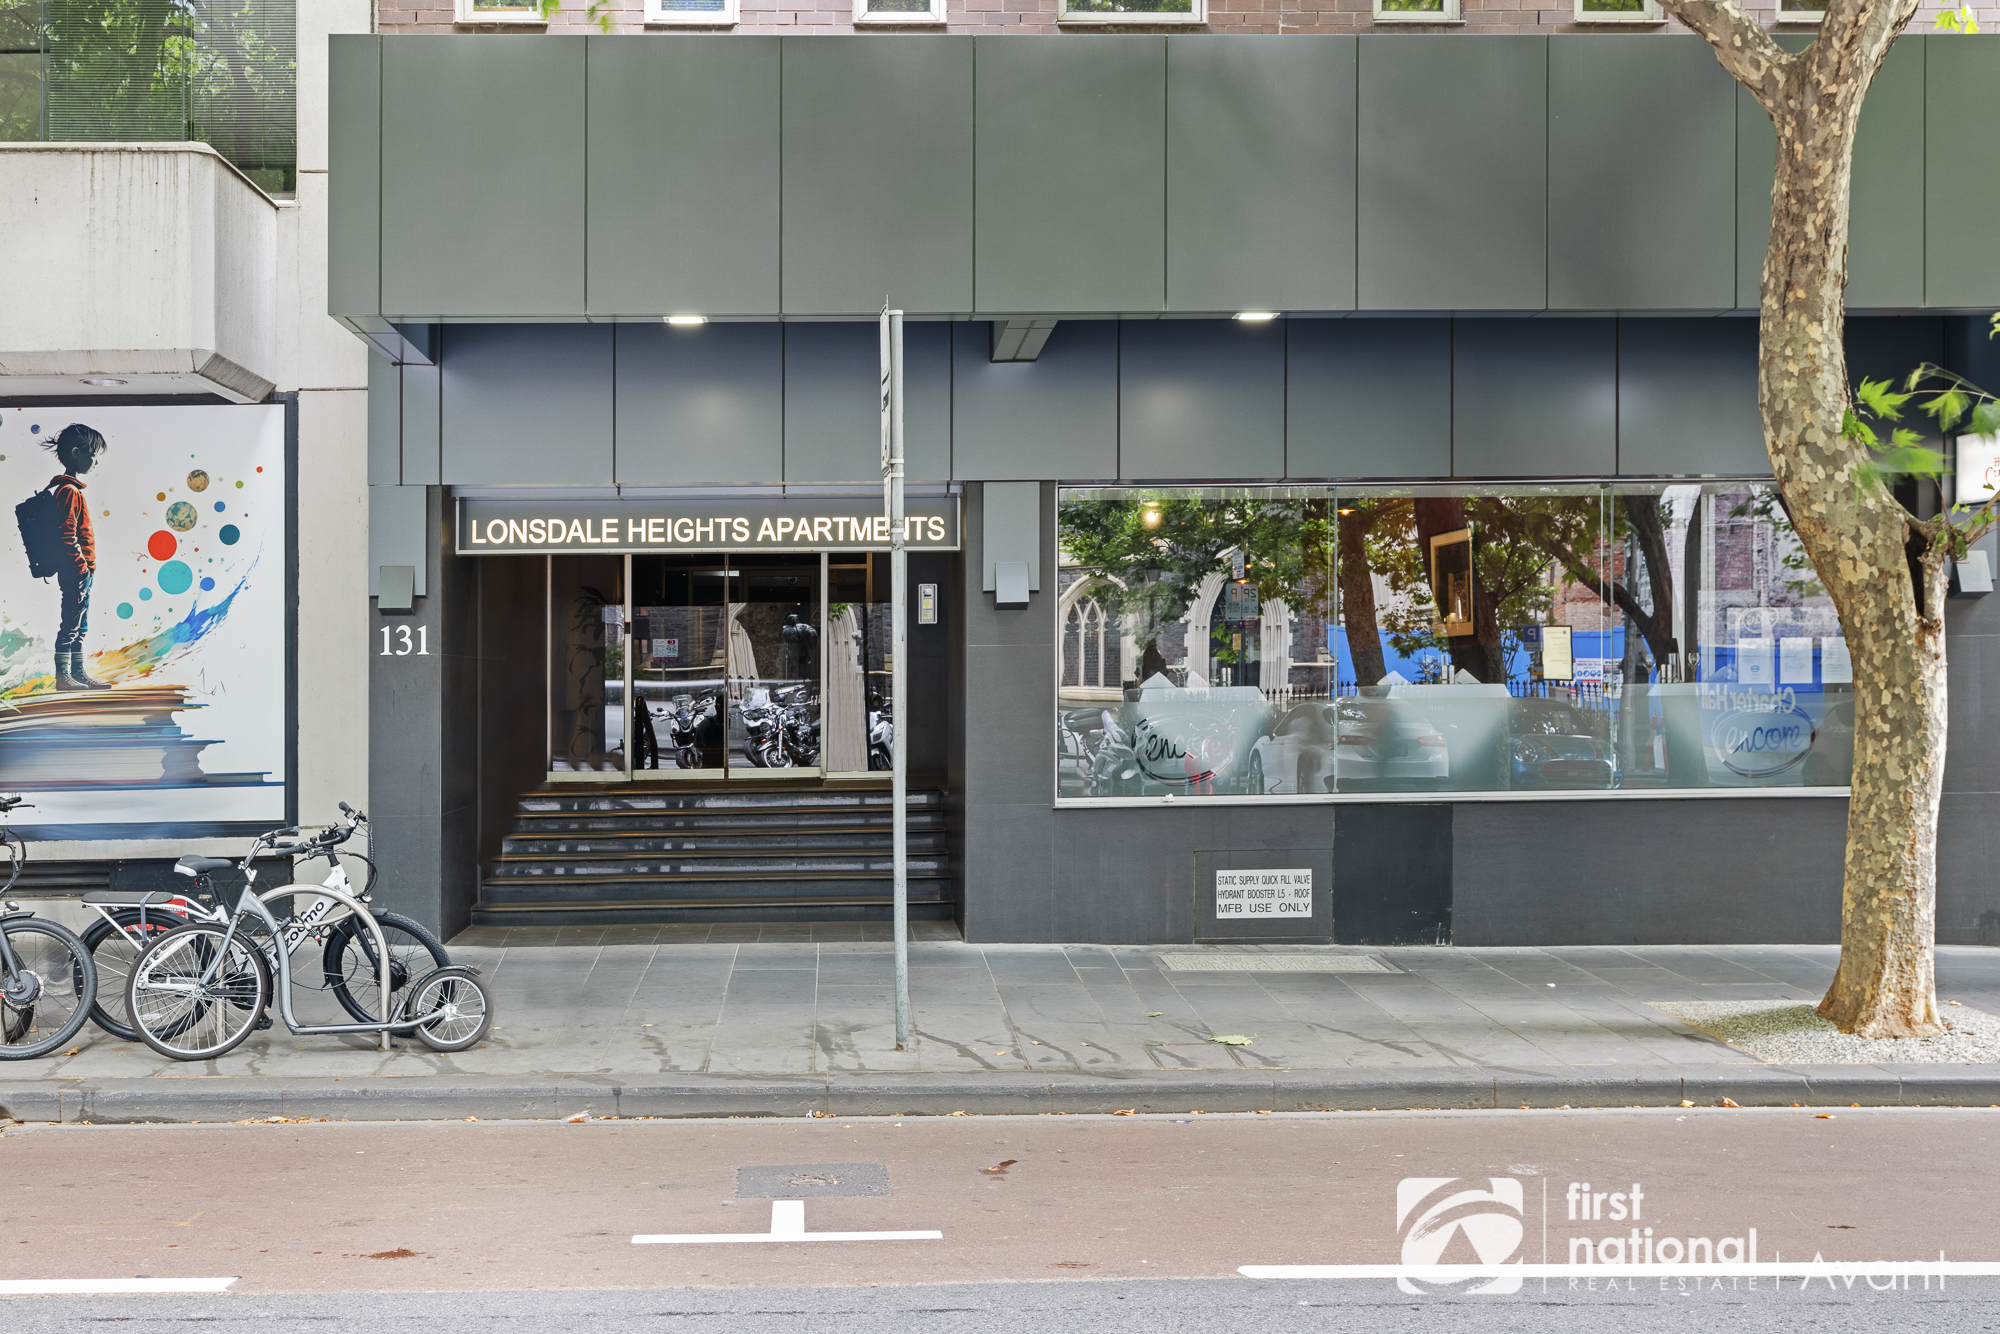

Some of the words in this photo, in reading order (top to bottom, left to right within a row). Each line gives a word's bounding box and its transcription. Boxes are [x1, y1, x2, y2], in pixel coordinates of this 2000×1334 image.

[472, 518, 619, 544] LONSDALE
[628, 517, 750, 543] HEIGHTS
[379, 624, 430, 656] 131
[1725, 725, 1803, 755] encore
[1218, 876, 1236, 886] STATIC
[1240, 875, 1260, 885] SUPPLY
[1262, 875, 1278, 885] QUICK
[1280, 875, 1292, 884] FILL
[1294, 875, 1310, 884] VALVE
[1218, 890, 1244, 899] HYDRANT
[1248, 889, 1275, 899] BOOSTER
[1278, 889, 1285, 898] L5
[1294, 888, 1310, 898] ROOF
[1218, 904, 1242, 913] MFB
[1249, 903, 1272, 913] USE
[1279, 902, 1310, 912] ONLY
